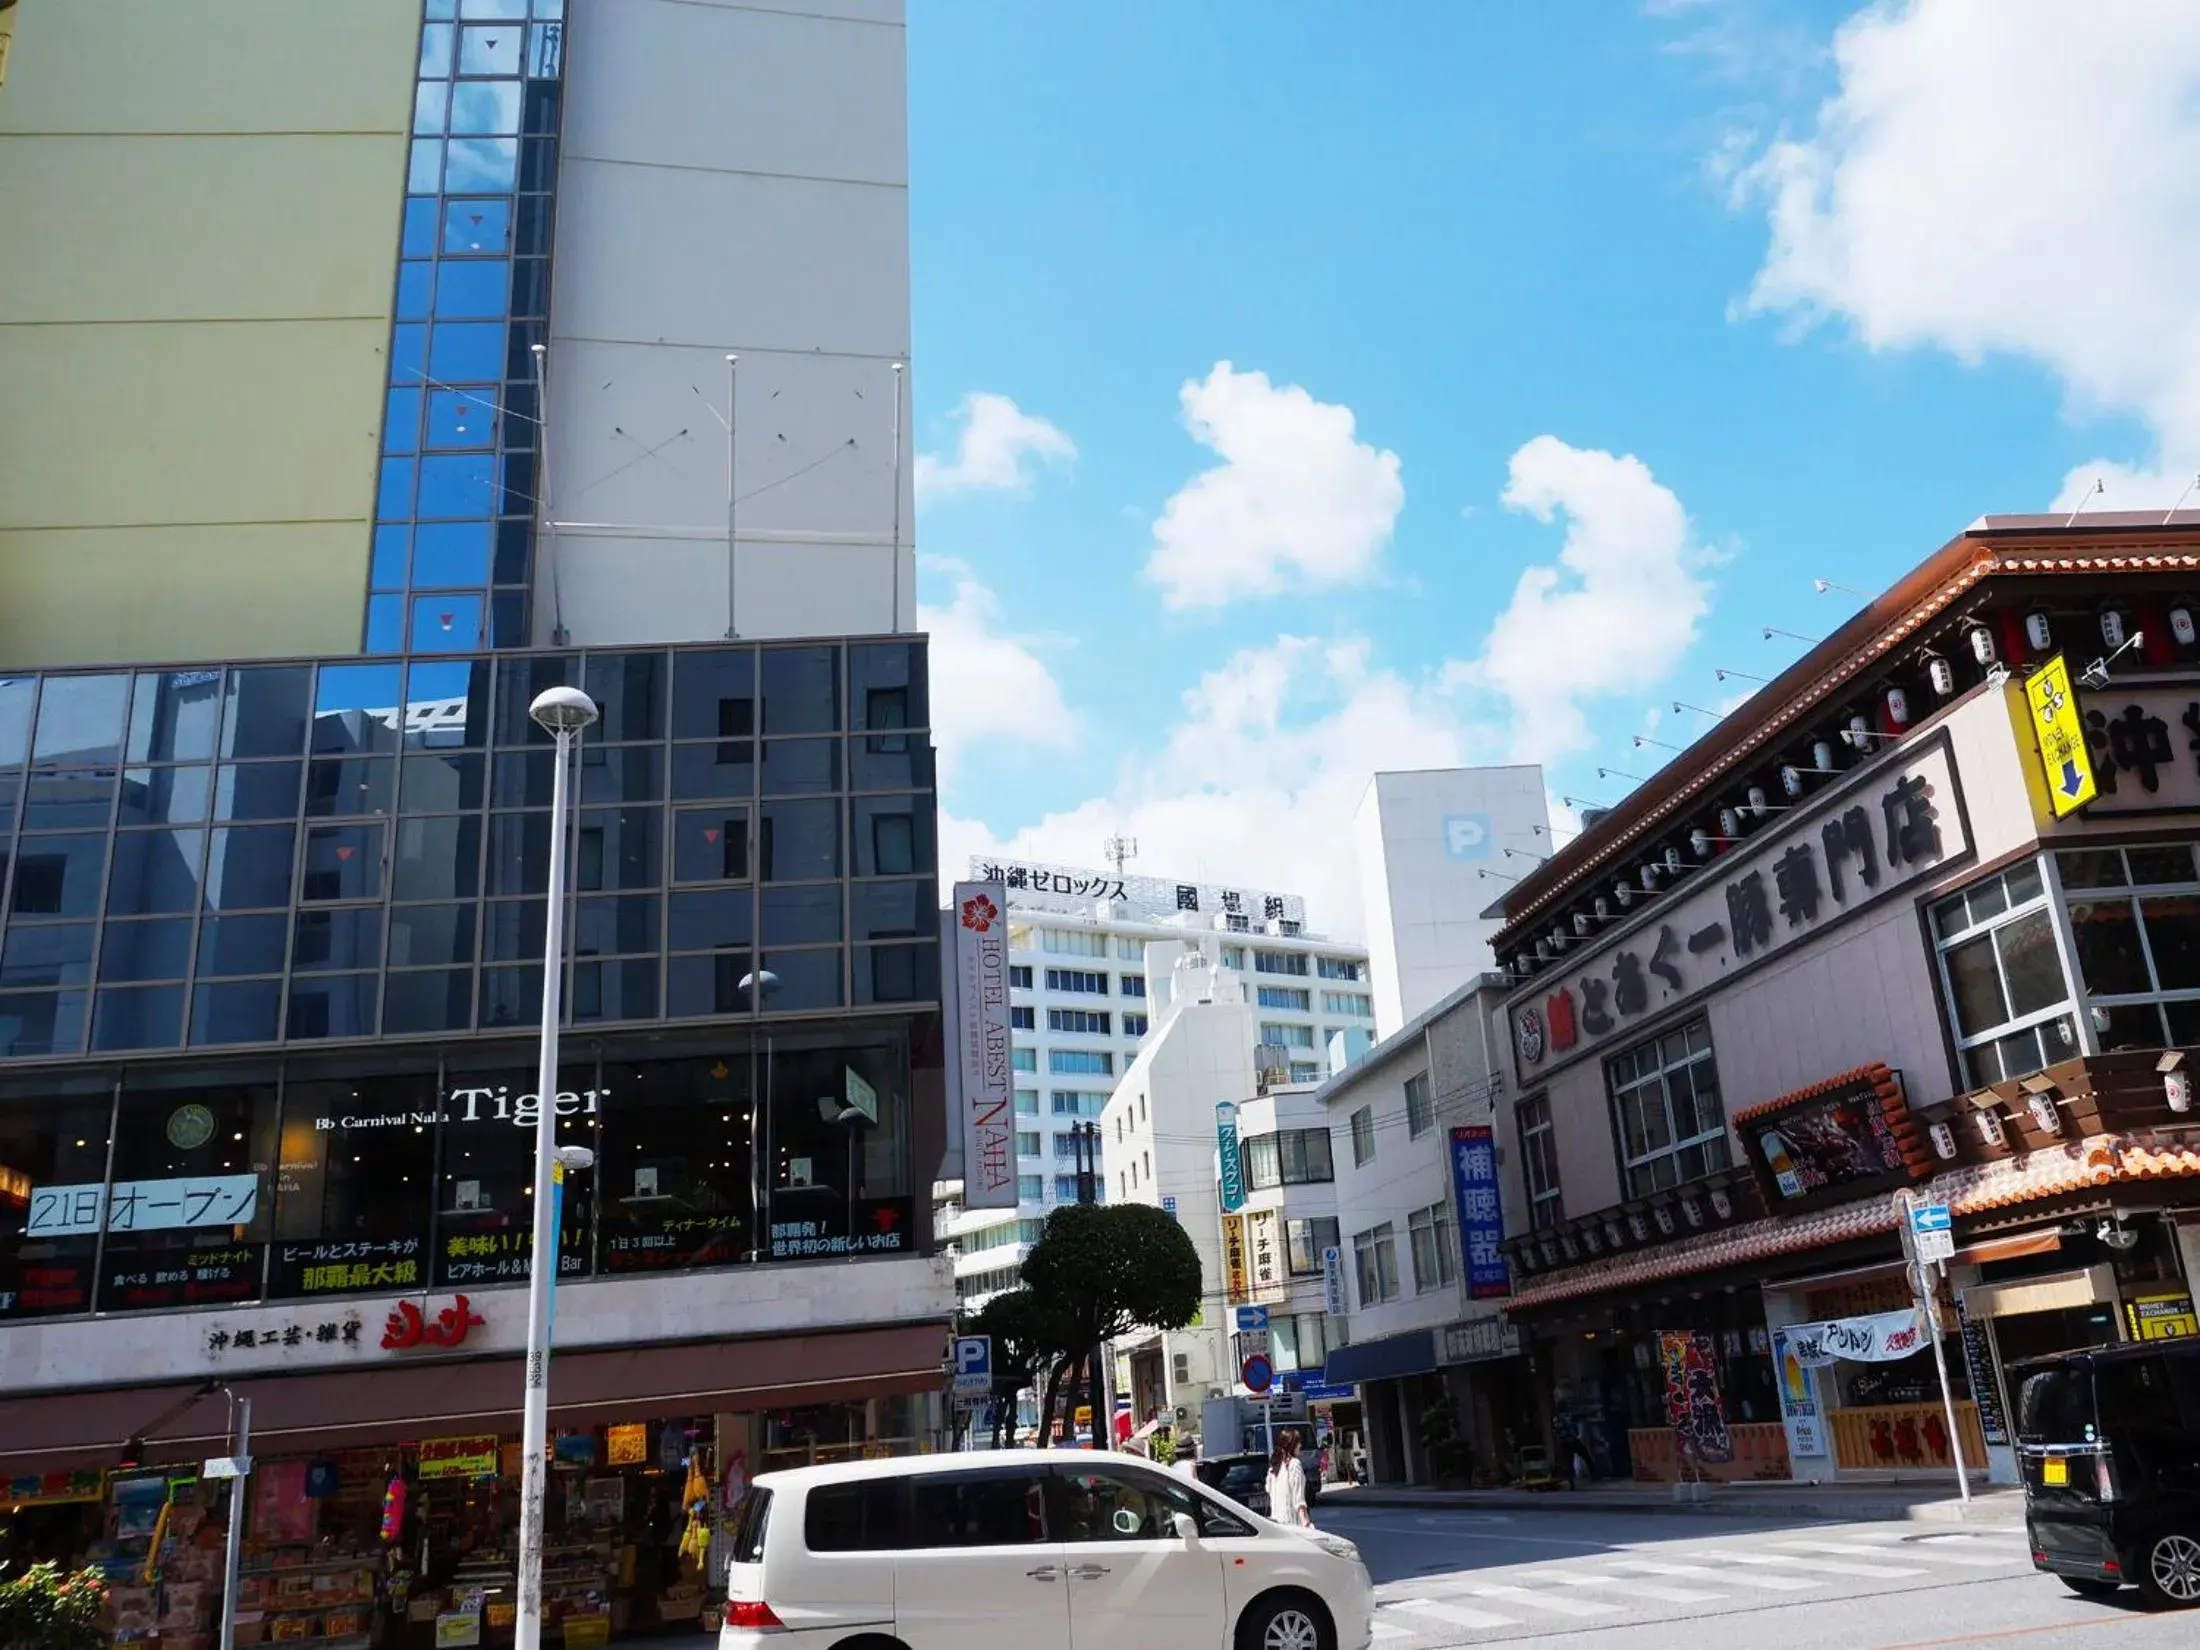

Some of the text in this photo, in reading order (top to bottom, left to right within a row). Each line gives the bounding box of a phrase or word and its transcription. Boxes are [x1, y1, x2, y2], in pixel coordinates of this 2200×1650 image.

[1448, 820, 1484, 854] P
[982, 937, 1003, 1011] HOTEL
[984, 1019, 1007, 1093] ABEST
[341, 1113, 406, 1128] Carnival
[451, 1085, 611, 1127] Tiger
[972, 1096, 1011, 1193] NAHA
[31, 1187, 257, 1230] 21日オープン
[661, 1215, 742, 1232] ディナータイム
[187, 1249, 253, 1266] ミッドナイト
[283, 1237, 419, 1262] ビールとステーキが
[771, 1232, 902, 1257] 世界初の新しいお店
[1255, 1211, 1273, 1282] リーチ麻雀
[303, 1259, 418, 1290] 那覇最大級
[561, 1255, 583, 1272] Bar
[958, 1340, 985, 1373] P
